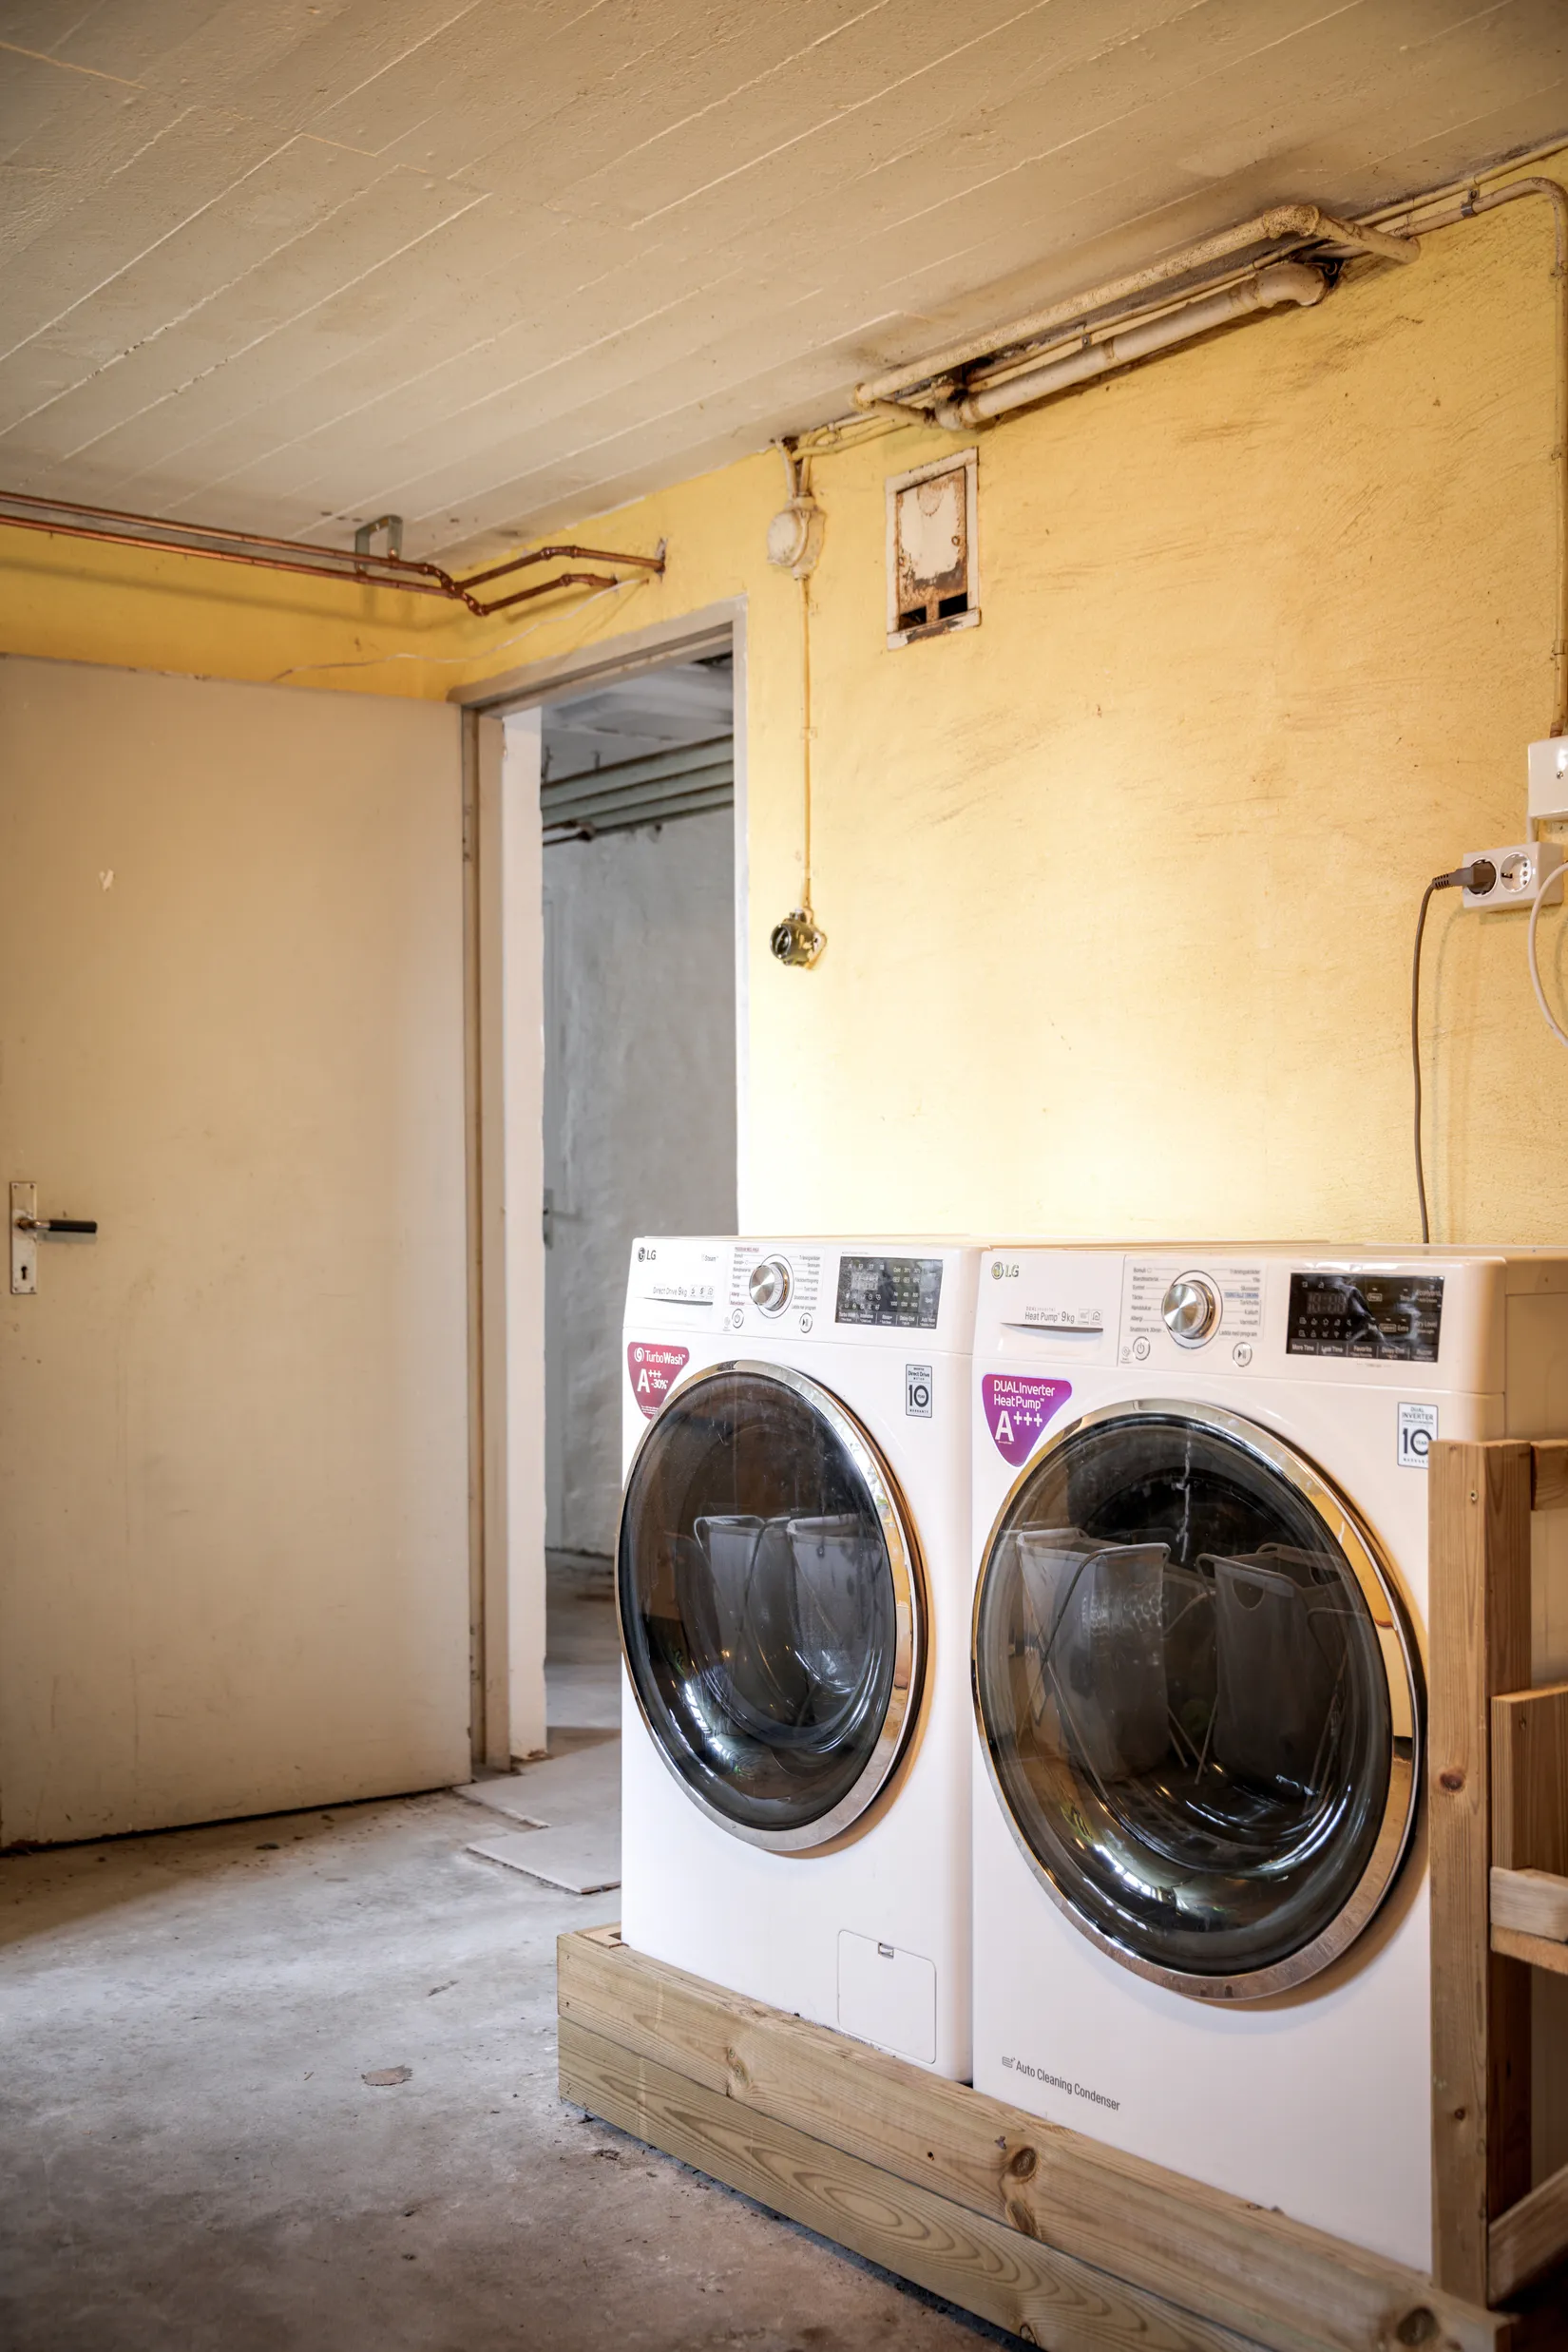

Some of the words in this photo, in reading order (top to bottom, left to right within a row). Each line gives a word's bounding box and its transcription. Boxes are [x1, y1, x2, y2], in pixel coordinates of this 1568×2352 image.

[646, 1249, 657, 1261] LG
[1004, 1264, 1020, 1278] LG
[1025, 1312, 1040, 1321] Heat
[1061, 1311, 1075, 1324] 9kg
[908, 1384, 929, 1408] 10
[993, 1379, 1019, 1394] DUAL
[1019, 1382, 1056, 1397] Inverter
[993, 1393, 1016, 1407] Heat
[1402, 1412, 1434, 1421] INVERTER
[994, 1409, 1043, 1443] A+++
[1403, 1427, 1433, 1456] 10
[1015, 2059, 1036, 2078] Auto
[1037, 2068, 1073, 2095] Cleaning
[1074, 2082, 1121, 2112] Condenser
